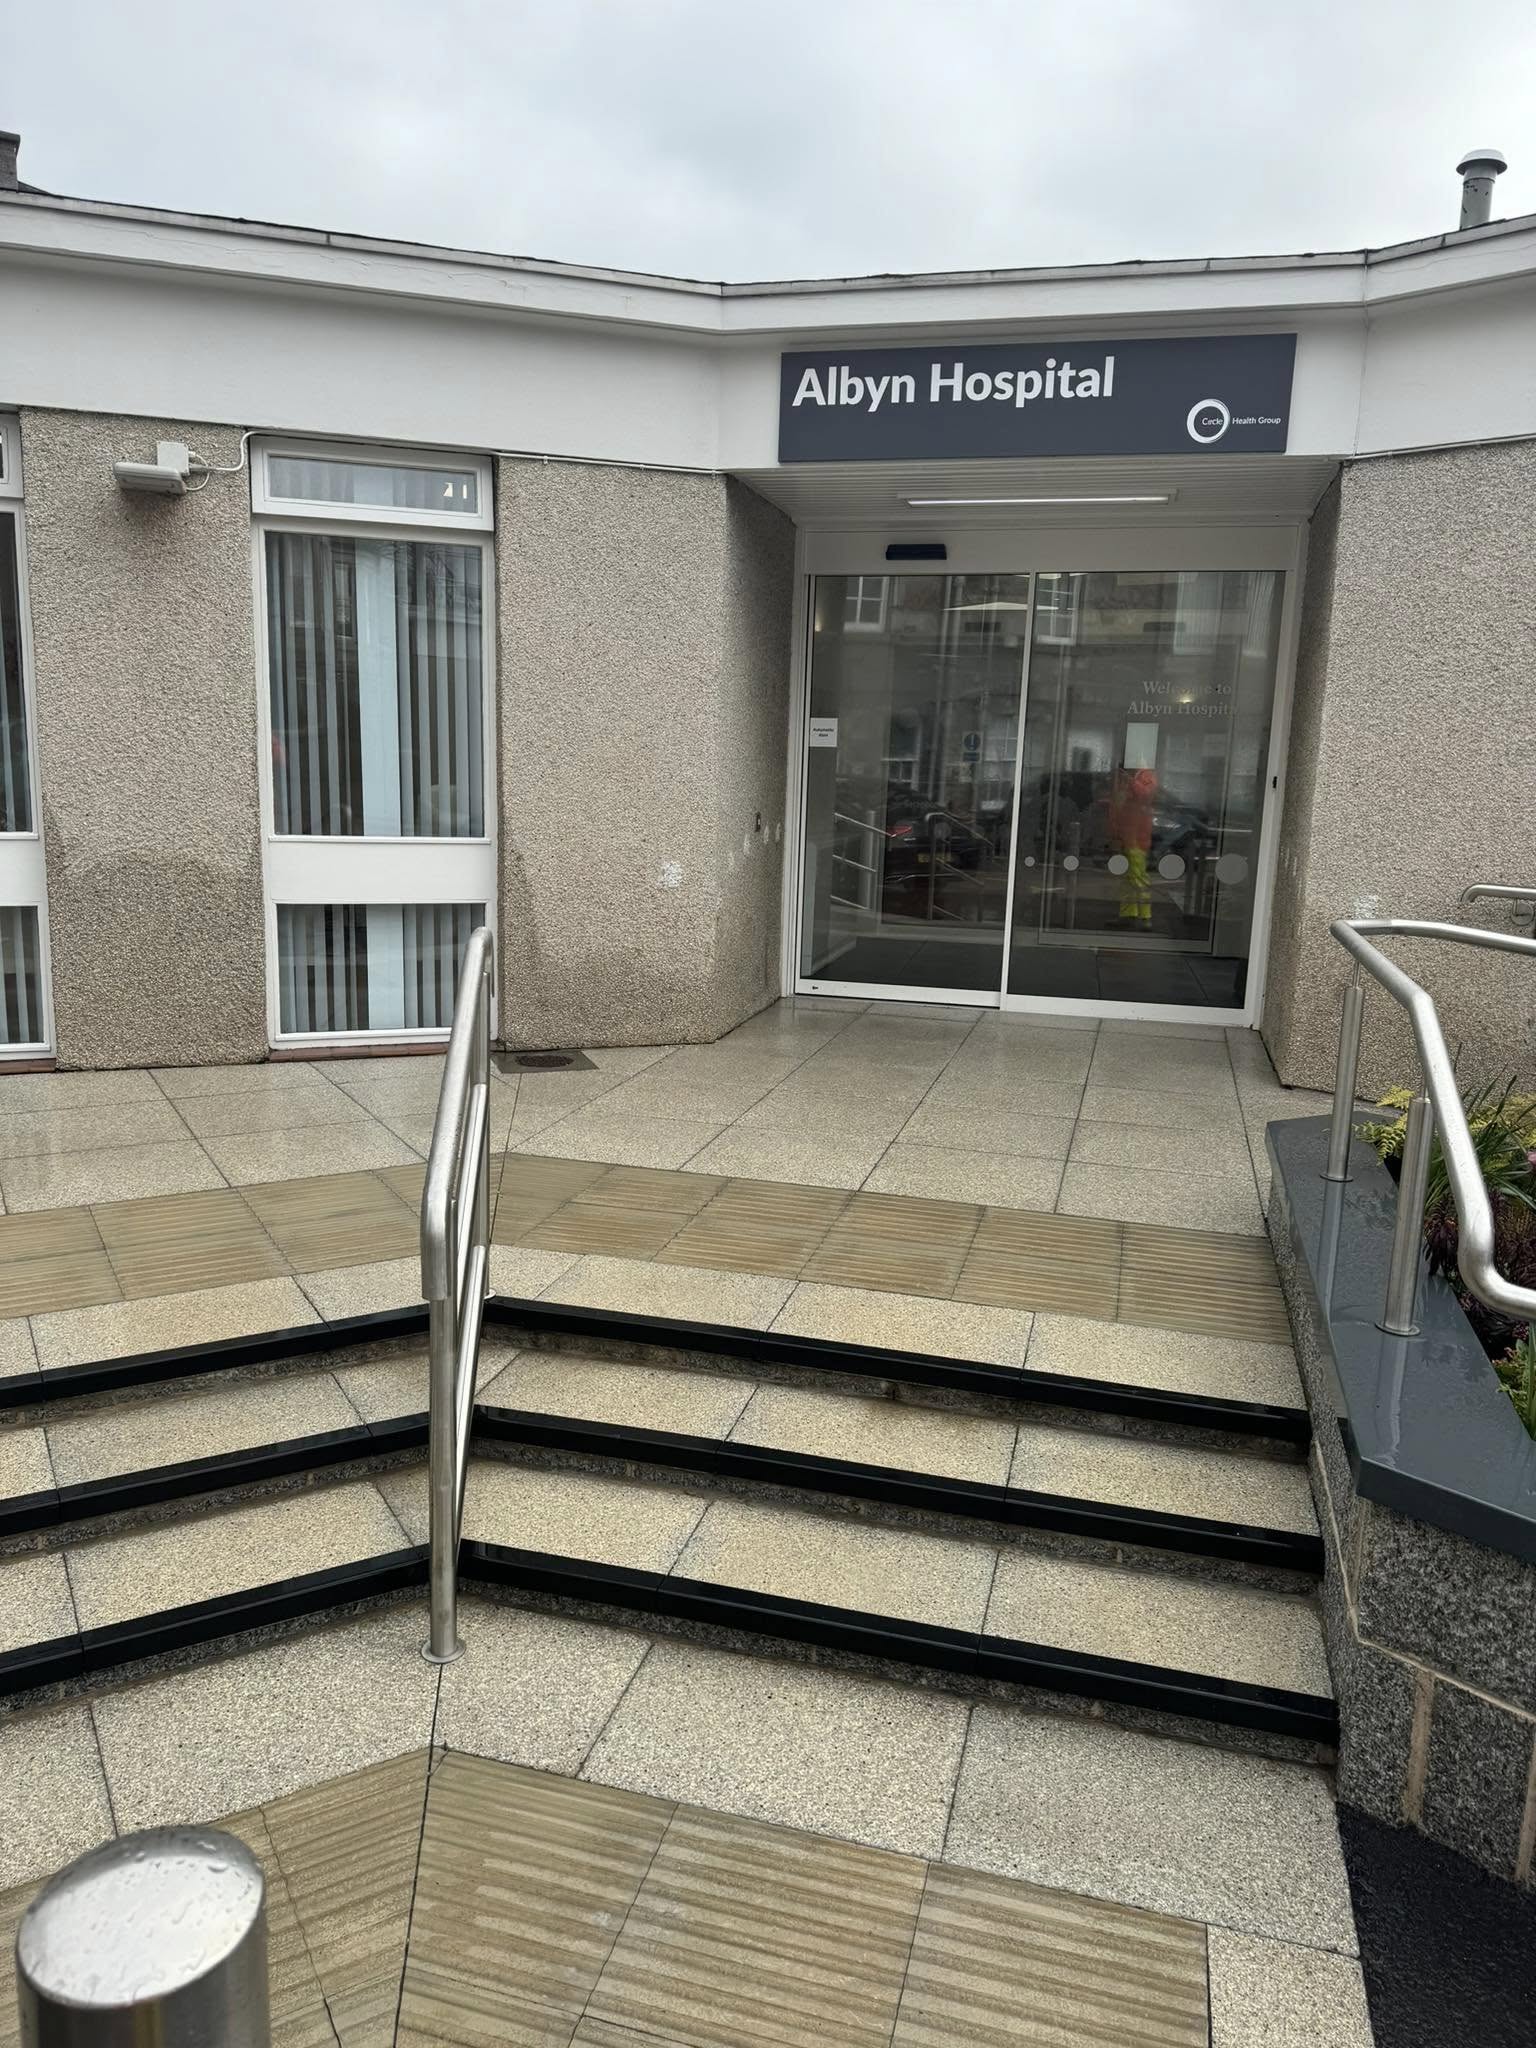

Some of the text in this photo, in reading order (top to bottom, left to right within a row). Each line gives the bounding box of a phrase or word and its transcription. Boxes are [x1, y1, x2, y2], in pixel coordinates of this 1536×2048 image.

[792, 355, 1115, 413] Albyn Hospital
[1201, 416, 1281, 426] Circle Health Group
[1143, 680, 1232, 695] Welcme to
[1127, 700, 1240, 718] Albyn Hospit
